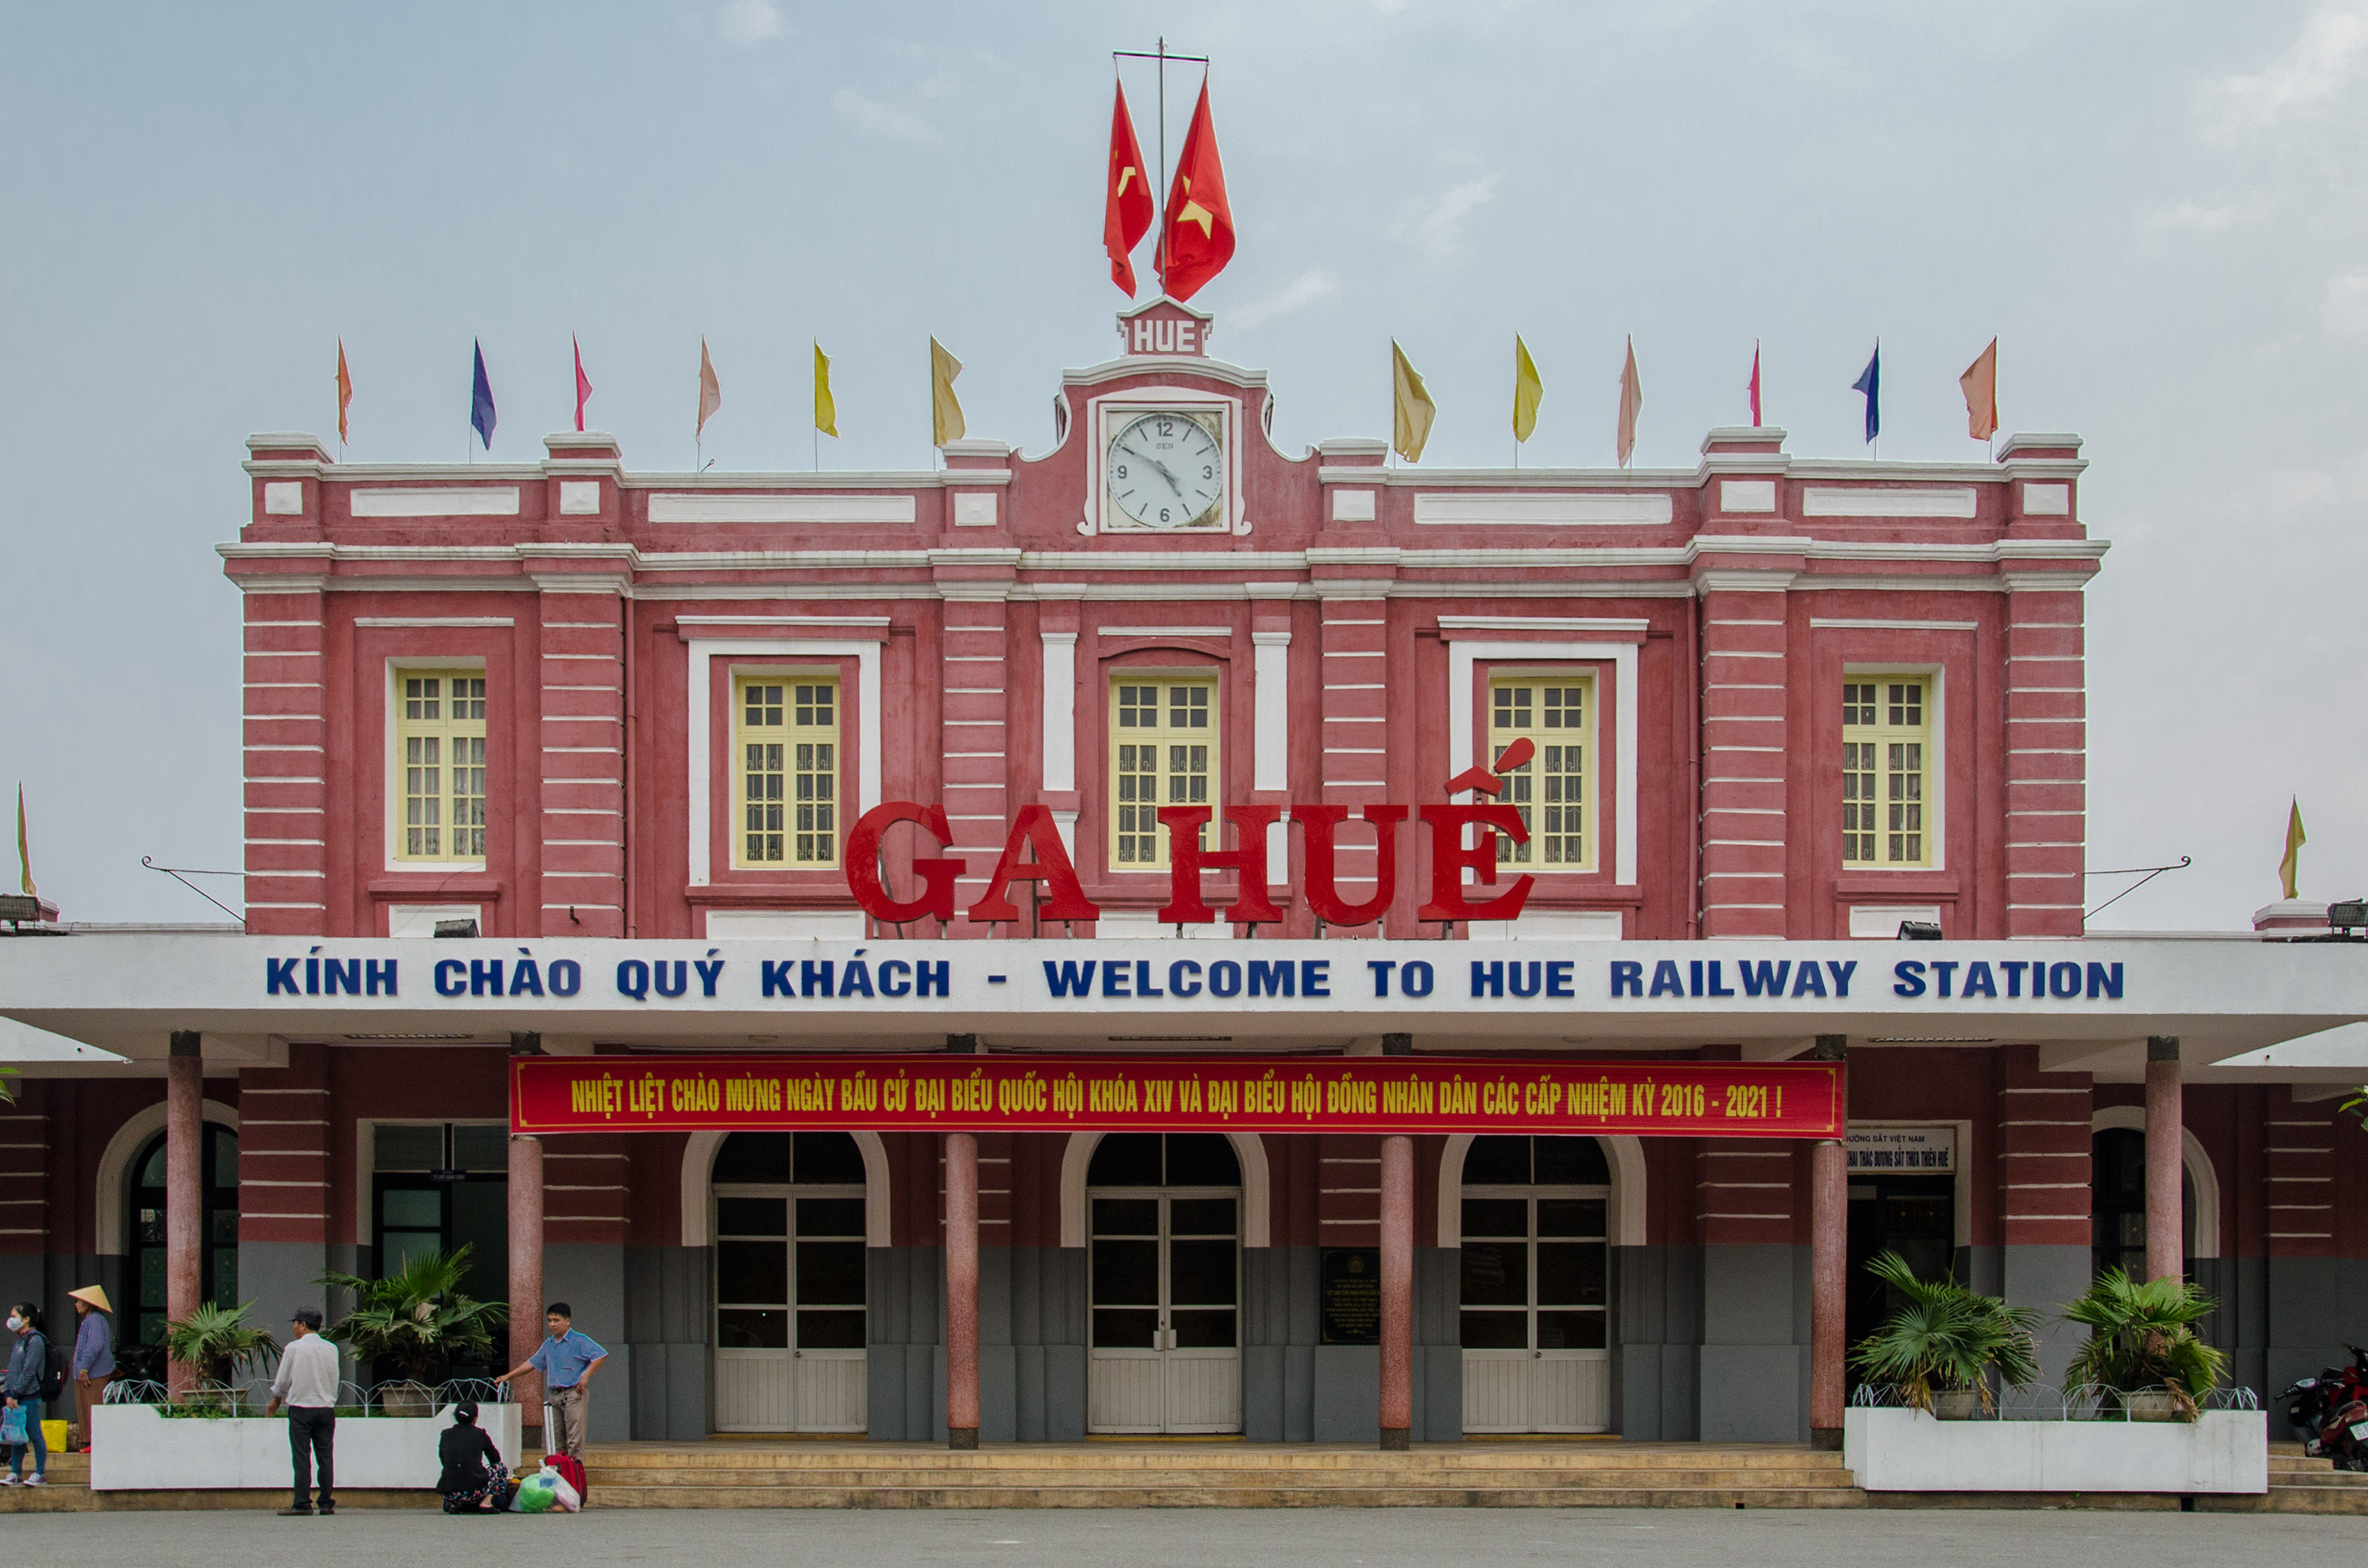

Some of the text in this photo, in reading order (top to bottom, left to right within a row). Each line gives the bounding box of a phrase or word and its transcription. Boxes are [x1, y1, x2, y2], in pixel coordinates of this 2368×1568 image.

[1134, 320, 1195, 352] HUE
[1156, 421, 1174, 437] 12
[1118, 465, 1127, 479] 9
[1202, 465, 1212, 480] 3
[1160, 507, 1170, 522] 6
[846, 737, 1535, 924] GA HUẾ
[267, 946, 396, 995] KÍNH
[434, 948, 580, 996] CHÀO
[617, 949, 725, 1000] QUÝ
[762, 949, 950, 997] KHÁCH
[1043, 960, 1330, 997] WELCOME
[1368, 961, 1433, 997] TO
[1471, 961, 1575, 997] HUE
[1611, 960, 1857, 997] RAILWAY
[1894, 960, 2124, 998] STATION
[571, 1072, 623, 1119] NHIỆT
[629, 1072, 665, 1119] LIỆT
[672, 1073, 720, 1112] CHÀO
[726, 1072, 781, 1112] MỪNG
[787, 1072, 834, 1111] NGÀY
[841, 1071, 877, 1111] BẦU
[883, 1069, 909, 1111] CỬ
[915, 1079, 945, 1119] ĐẠI
[952, 1068, 992, 1112] BIỂU
[999, 1071, 1047, 1116] QUỐC
[1053, 1072, 1083, 1119] HỘI
[1089, 1073, 1138, 1113] KHÓA
[1144, 1080, 1173, 1112] XIV
[1179, 1073, 1202, 1113] VÀ
[1208, 1080, 1238, 1120] ĐẠI
[1244, 1069, 1285, 1113] BIỂU
[1291, 1073, 1321, 1121] HỘI
[1327, 1072, 1377, 1113] ĐỒNG
[1383, 1074, 1433, 1113] NHÂN
[1440, 1074, 1477, 1114] DÂN
[1483, 1076, 1519, 1115] CÁC
[1525, 1075, 1561, 1115] CẤP
[1568, 1076, 1626, 1123] NHIỆM
[1632, 1076, 1655, 1116] KỲ
[1661, 1084, 1705, 1117] 2016
[1725, 1085, 1767, 1117] 2021
[1890, 1133, 1906, 1143] VIỆT
[1921, 1147, 1937, 1166] THIÊN
[1938, 1147, 1949, 1166] HUẾ
